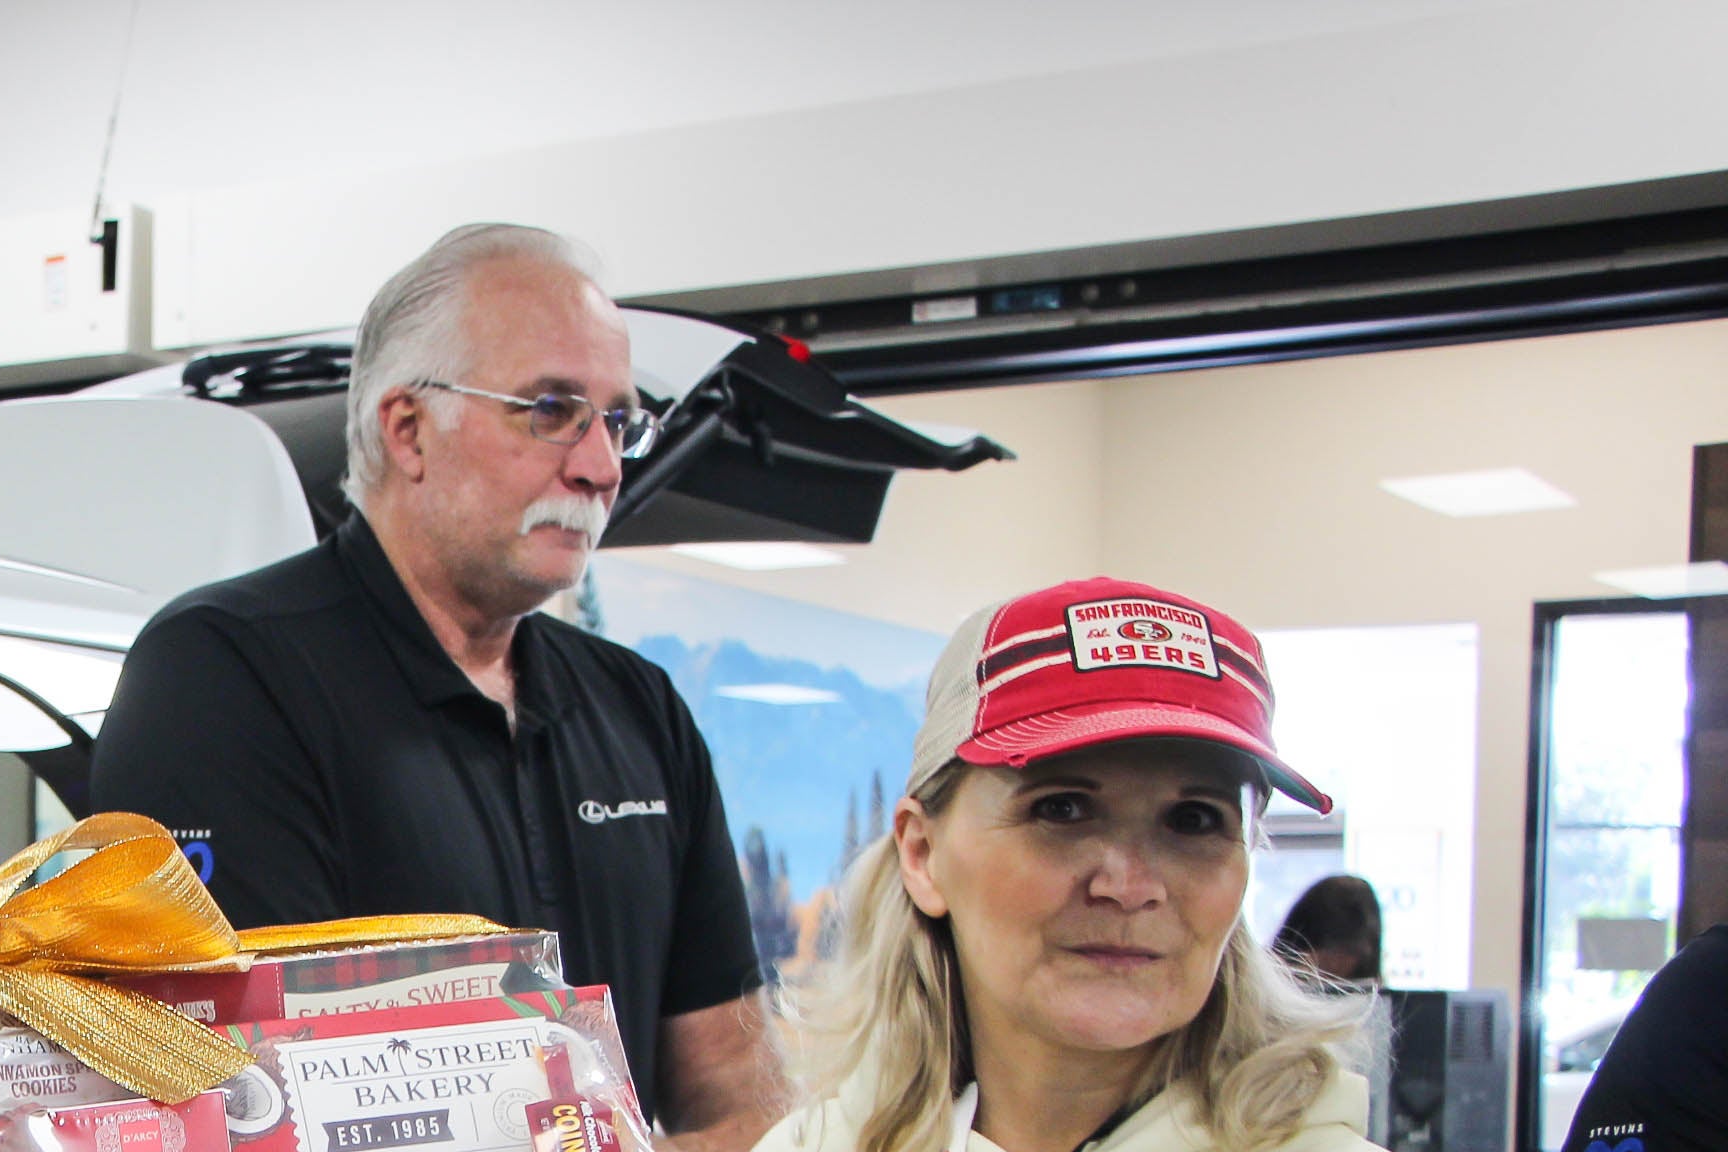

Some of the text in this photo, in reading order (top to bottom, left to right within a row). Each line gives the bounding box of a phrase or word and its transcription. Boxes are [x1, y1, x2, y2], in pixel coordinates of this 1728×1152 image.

[1075, 603, 1203, 629] SAN FRANCISCO
[1091, 645, 1205, 669] 49ERS
[408, 975, 498, 1007] SWEET
[299, 1038, 534, 1082] PALM STREET
[11, 1076, 77, 1098] COOKIES
[355, 1072, 495, 1108] BAKERY
[123, 1130, 159, 1144] D'ARCY
[336, 1116, 441, 1146] EST. 1985
[1589, 1123, 1643, 1138] STEVENS
